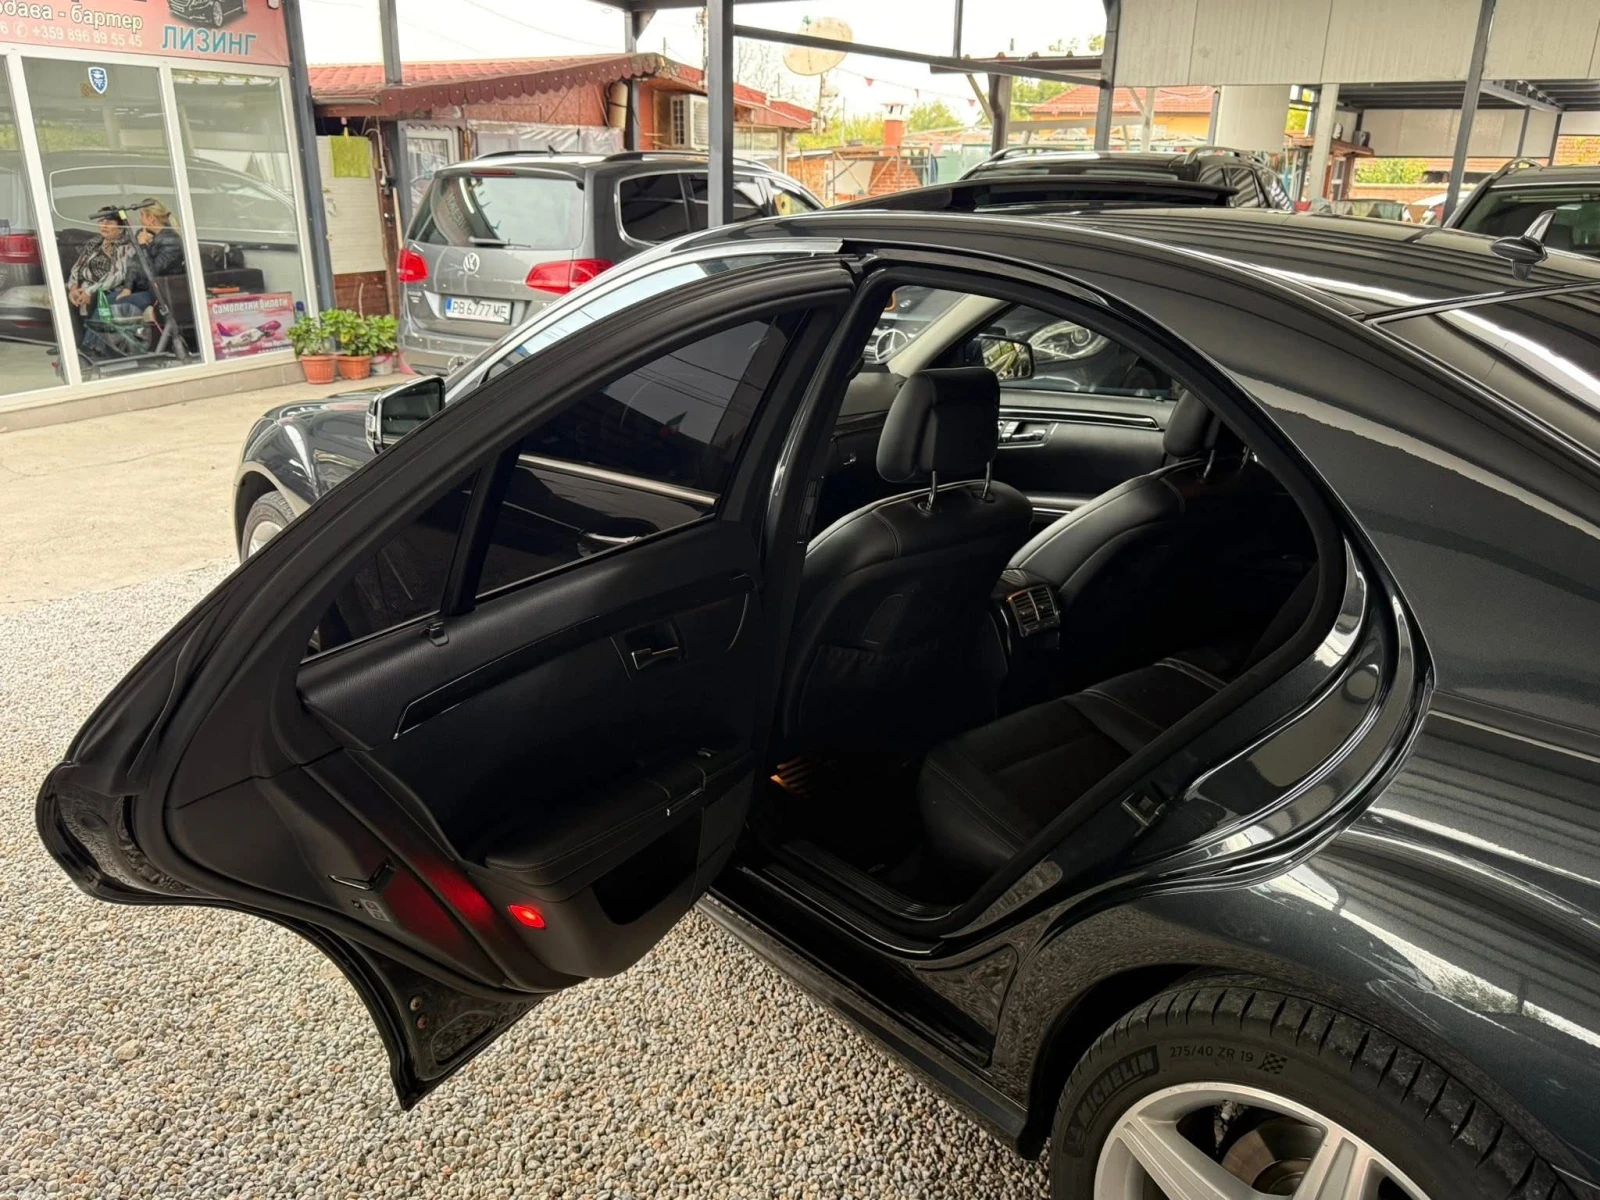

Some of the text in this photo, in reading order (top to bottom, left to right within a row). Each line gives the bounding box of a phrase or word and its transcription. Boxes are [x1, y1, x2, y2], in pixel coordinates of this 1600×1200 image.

[0, 0, 53, 20] дава
[71, 4, 143, 33] бартер
[32, 25, 64, 40] +359
[67, 28, 91, 43] 896
[93, 31, 108, 45] 89
[111, 33, 125, 47] 55
[128, 35, 143, 48] 45
[162, 25, 257, 56] ЛИЗИНГ
[1169, 1046, 1254, 1062] 275/40 ZR 19
[1077, 1051, 1156, 1126] MICHELIN
